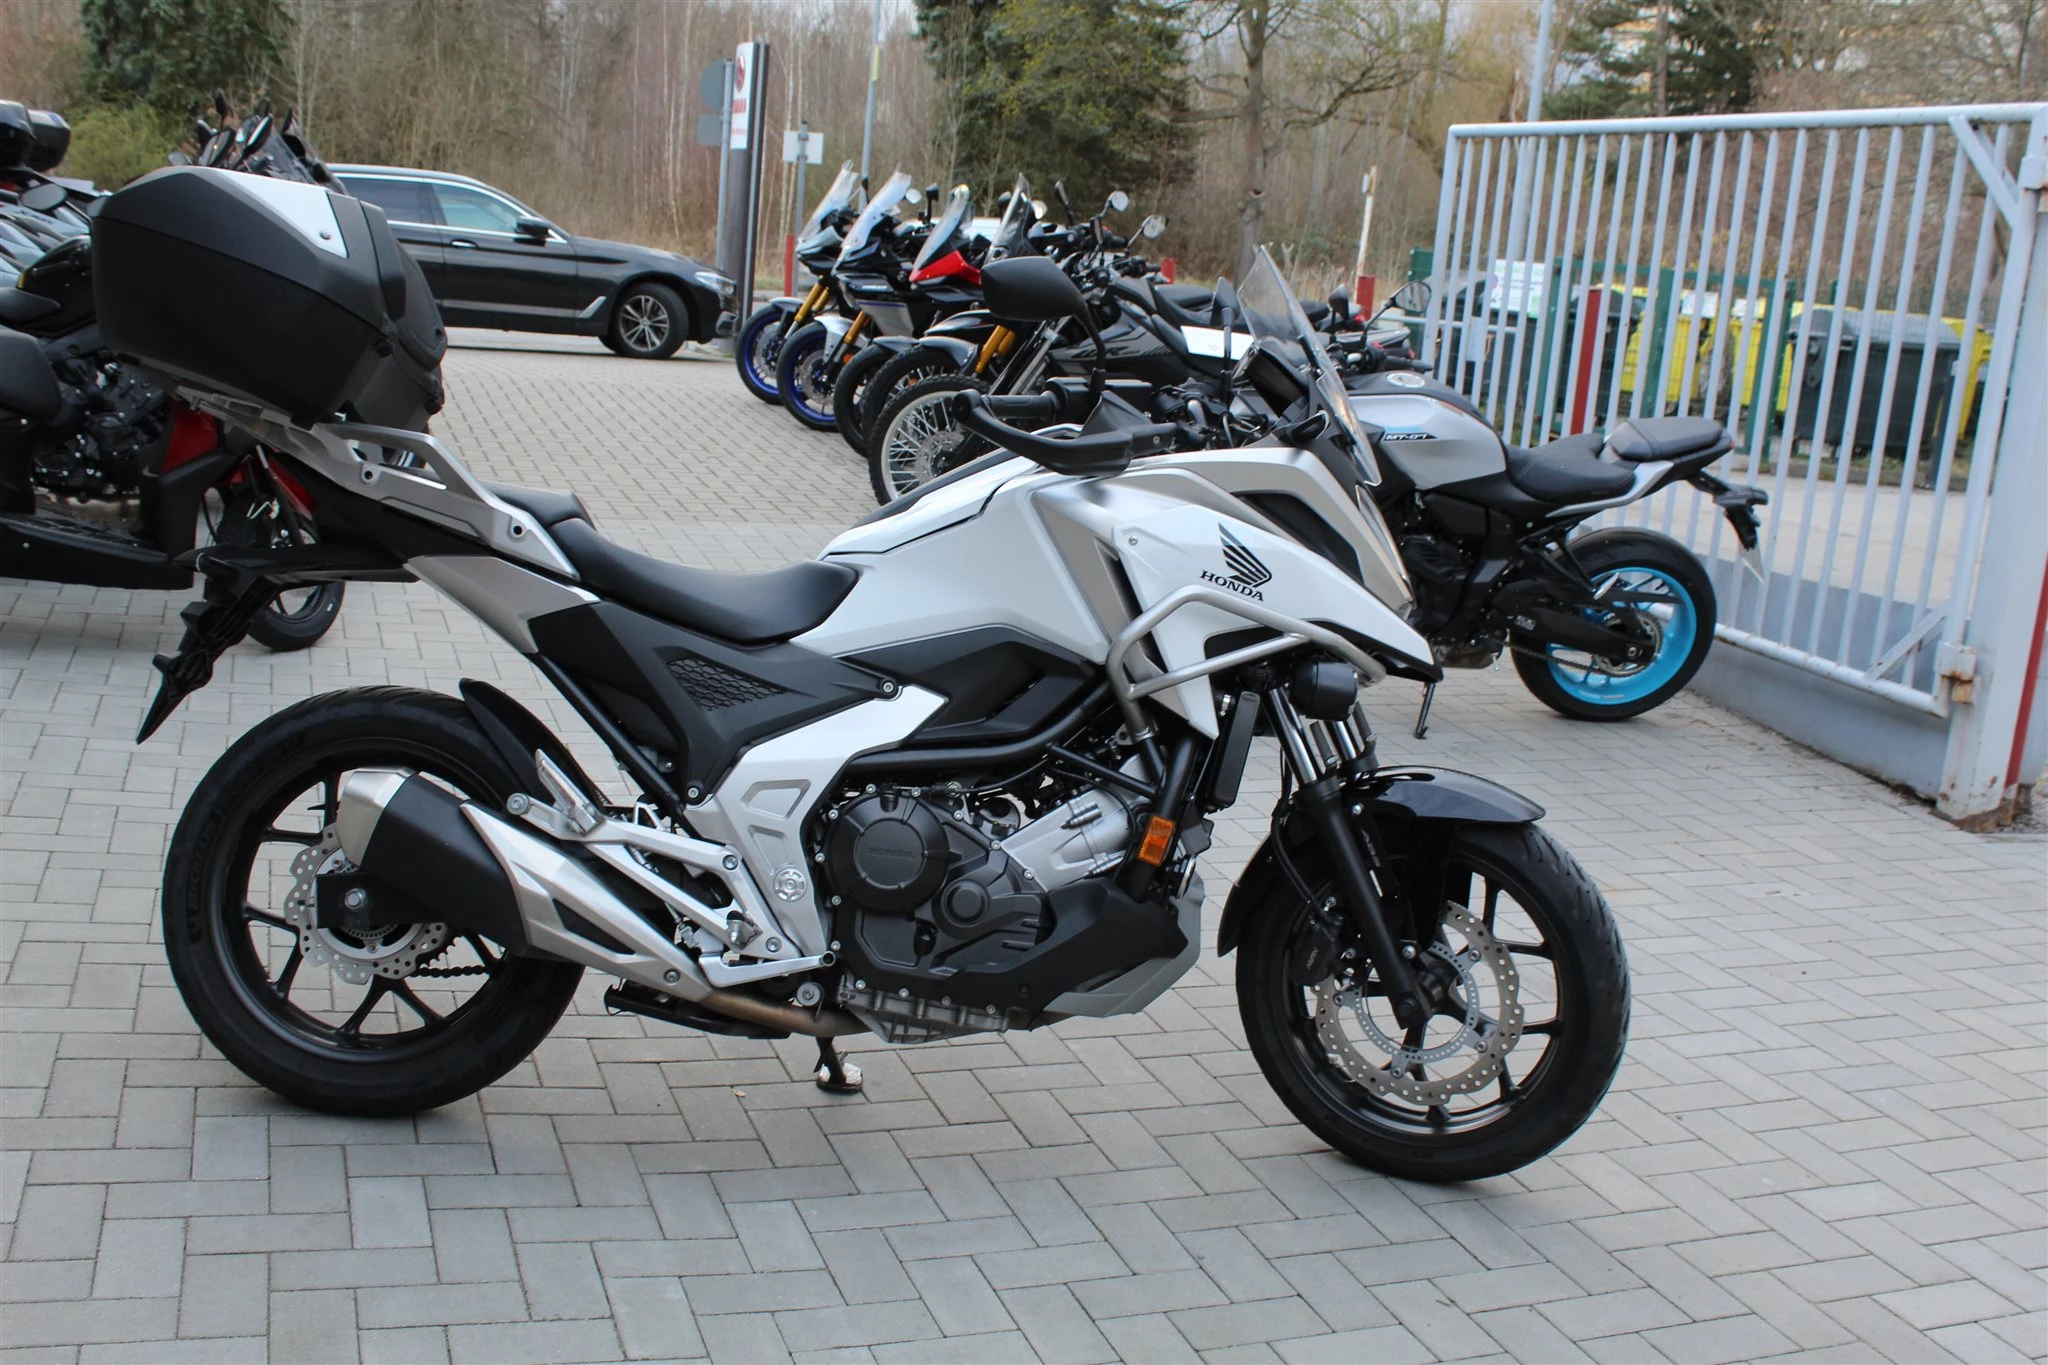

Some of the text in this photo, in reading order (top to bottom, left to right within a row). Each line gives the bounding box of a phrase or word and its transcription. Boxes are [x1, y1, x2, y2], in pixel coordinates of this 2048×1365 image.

[1386, 433, 1428, 441] MT-07
[1200, 569, 1265, 602] HONDA
[187, 817, 218, 912] MICHELIN
